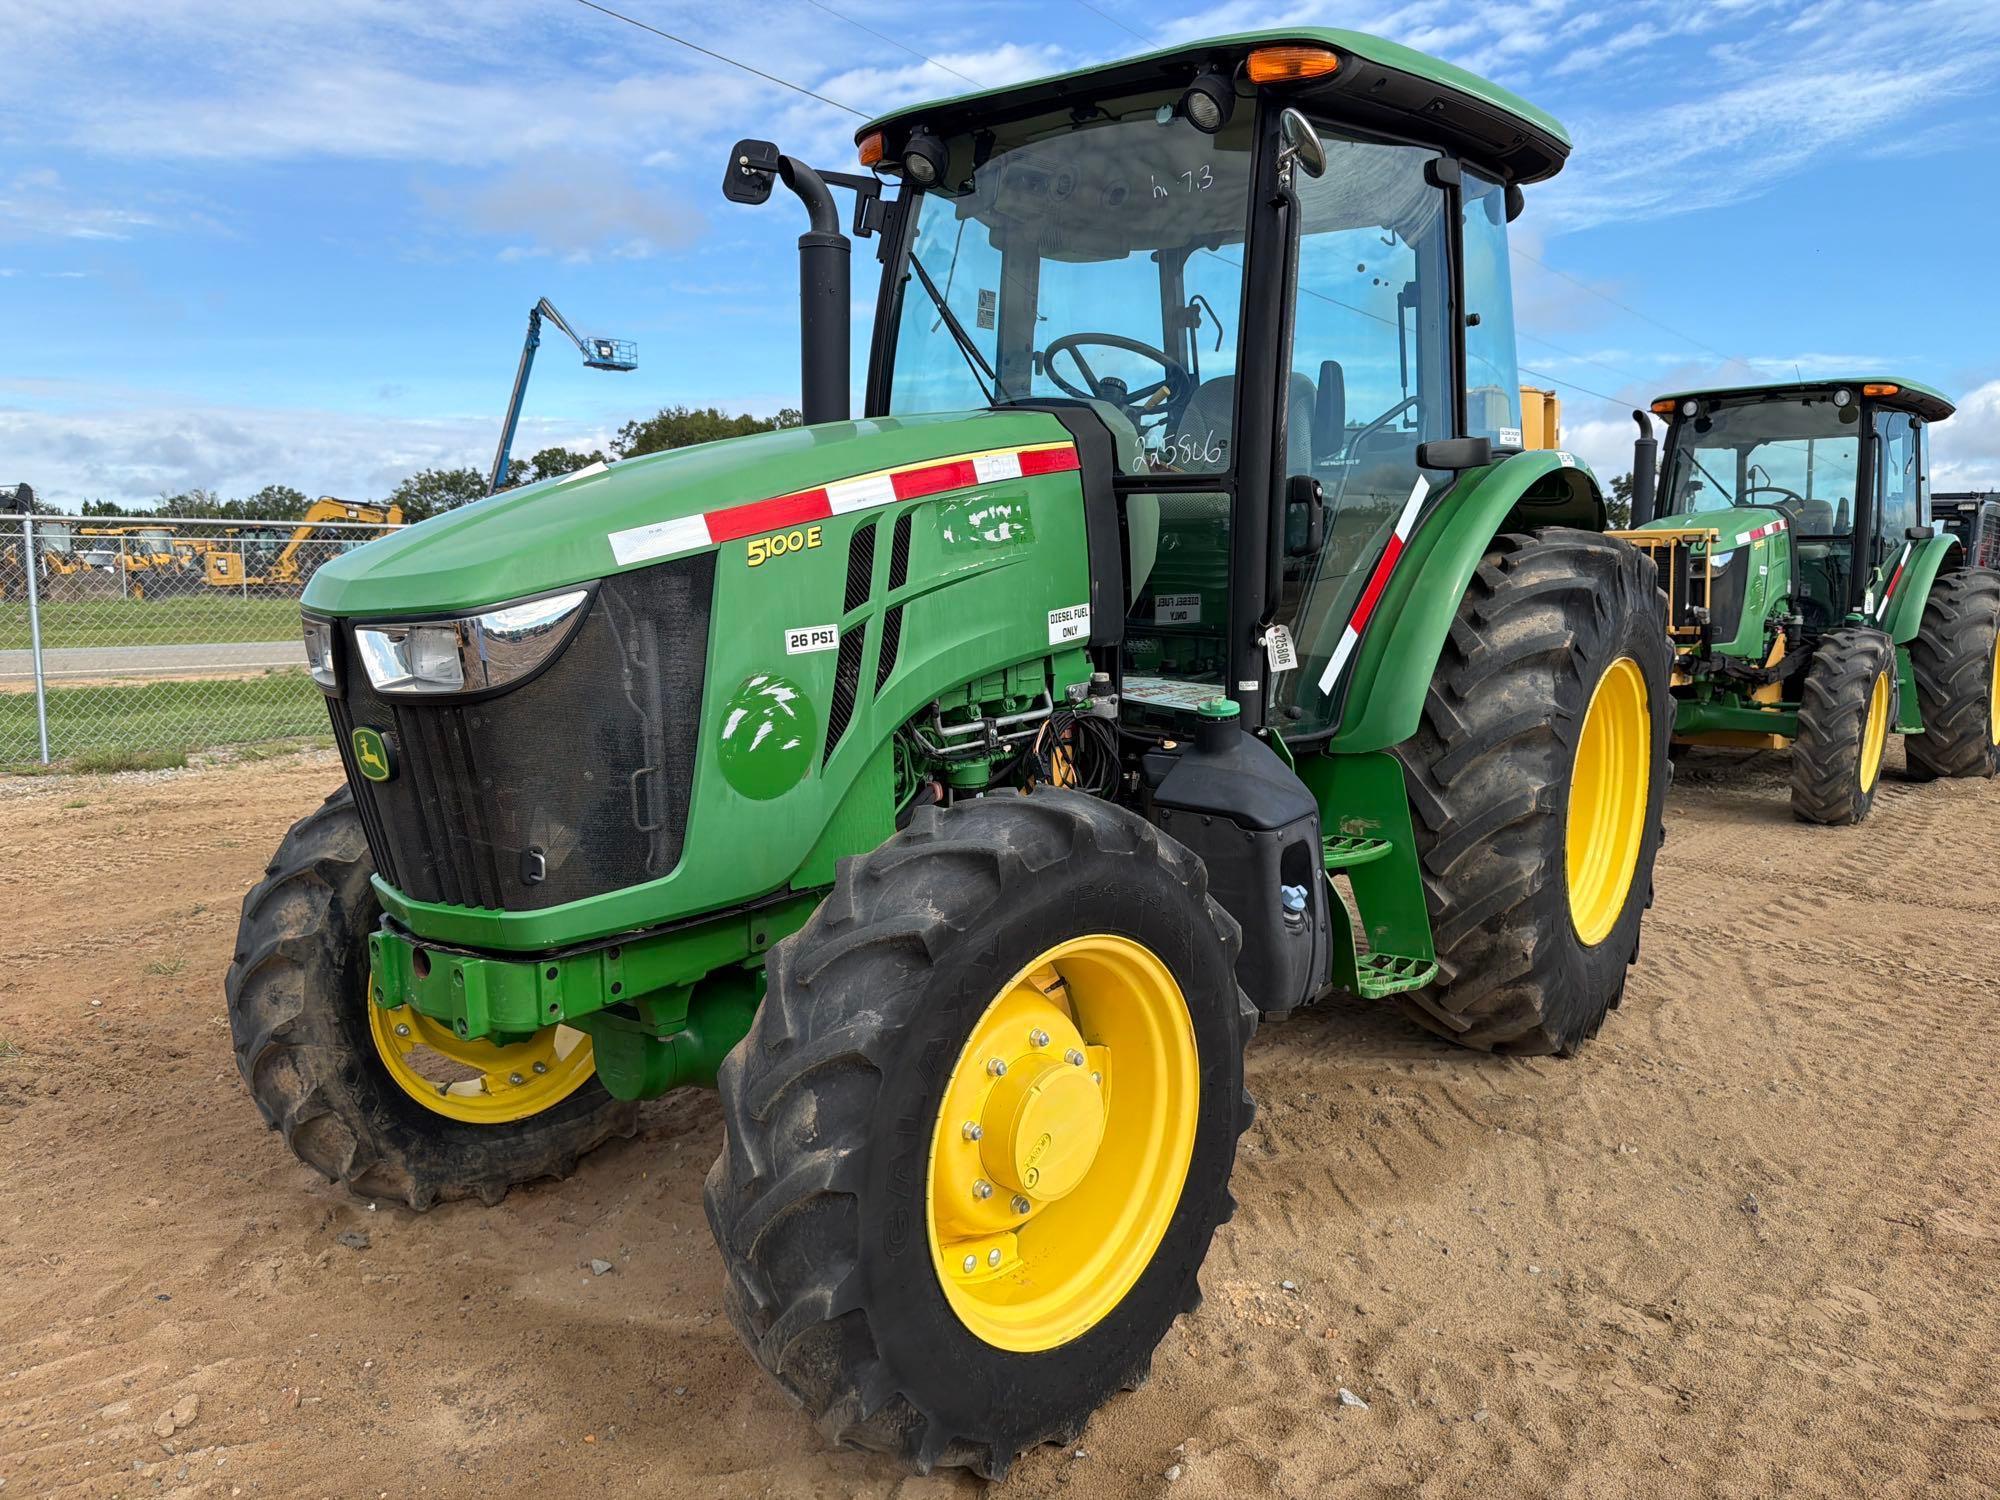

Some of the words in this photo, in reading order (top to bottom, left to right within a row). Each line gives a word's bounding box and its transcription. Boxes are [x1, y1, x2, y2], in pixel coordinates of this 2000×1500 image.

[1132, 429, 1222, 473] 225806
[1050, 610, 1073, 624] DIESEL
[1074, 607, 1088, 619] FUEL
[790, 634, 808, 648] 26
[811, 630, 834, 645] PSI
[1062, 625, 1078, 638] ONLY
[1274, 633, 1291, 665] 225806
